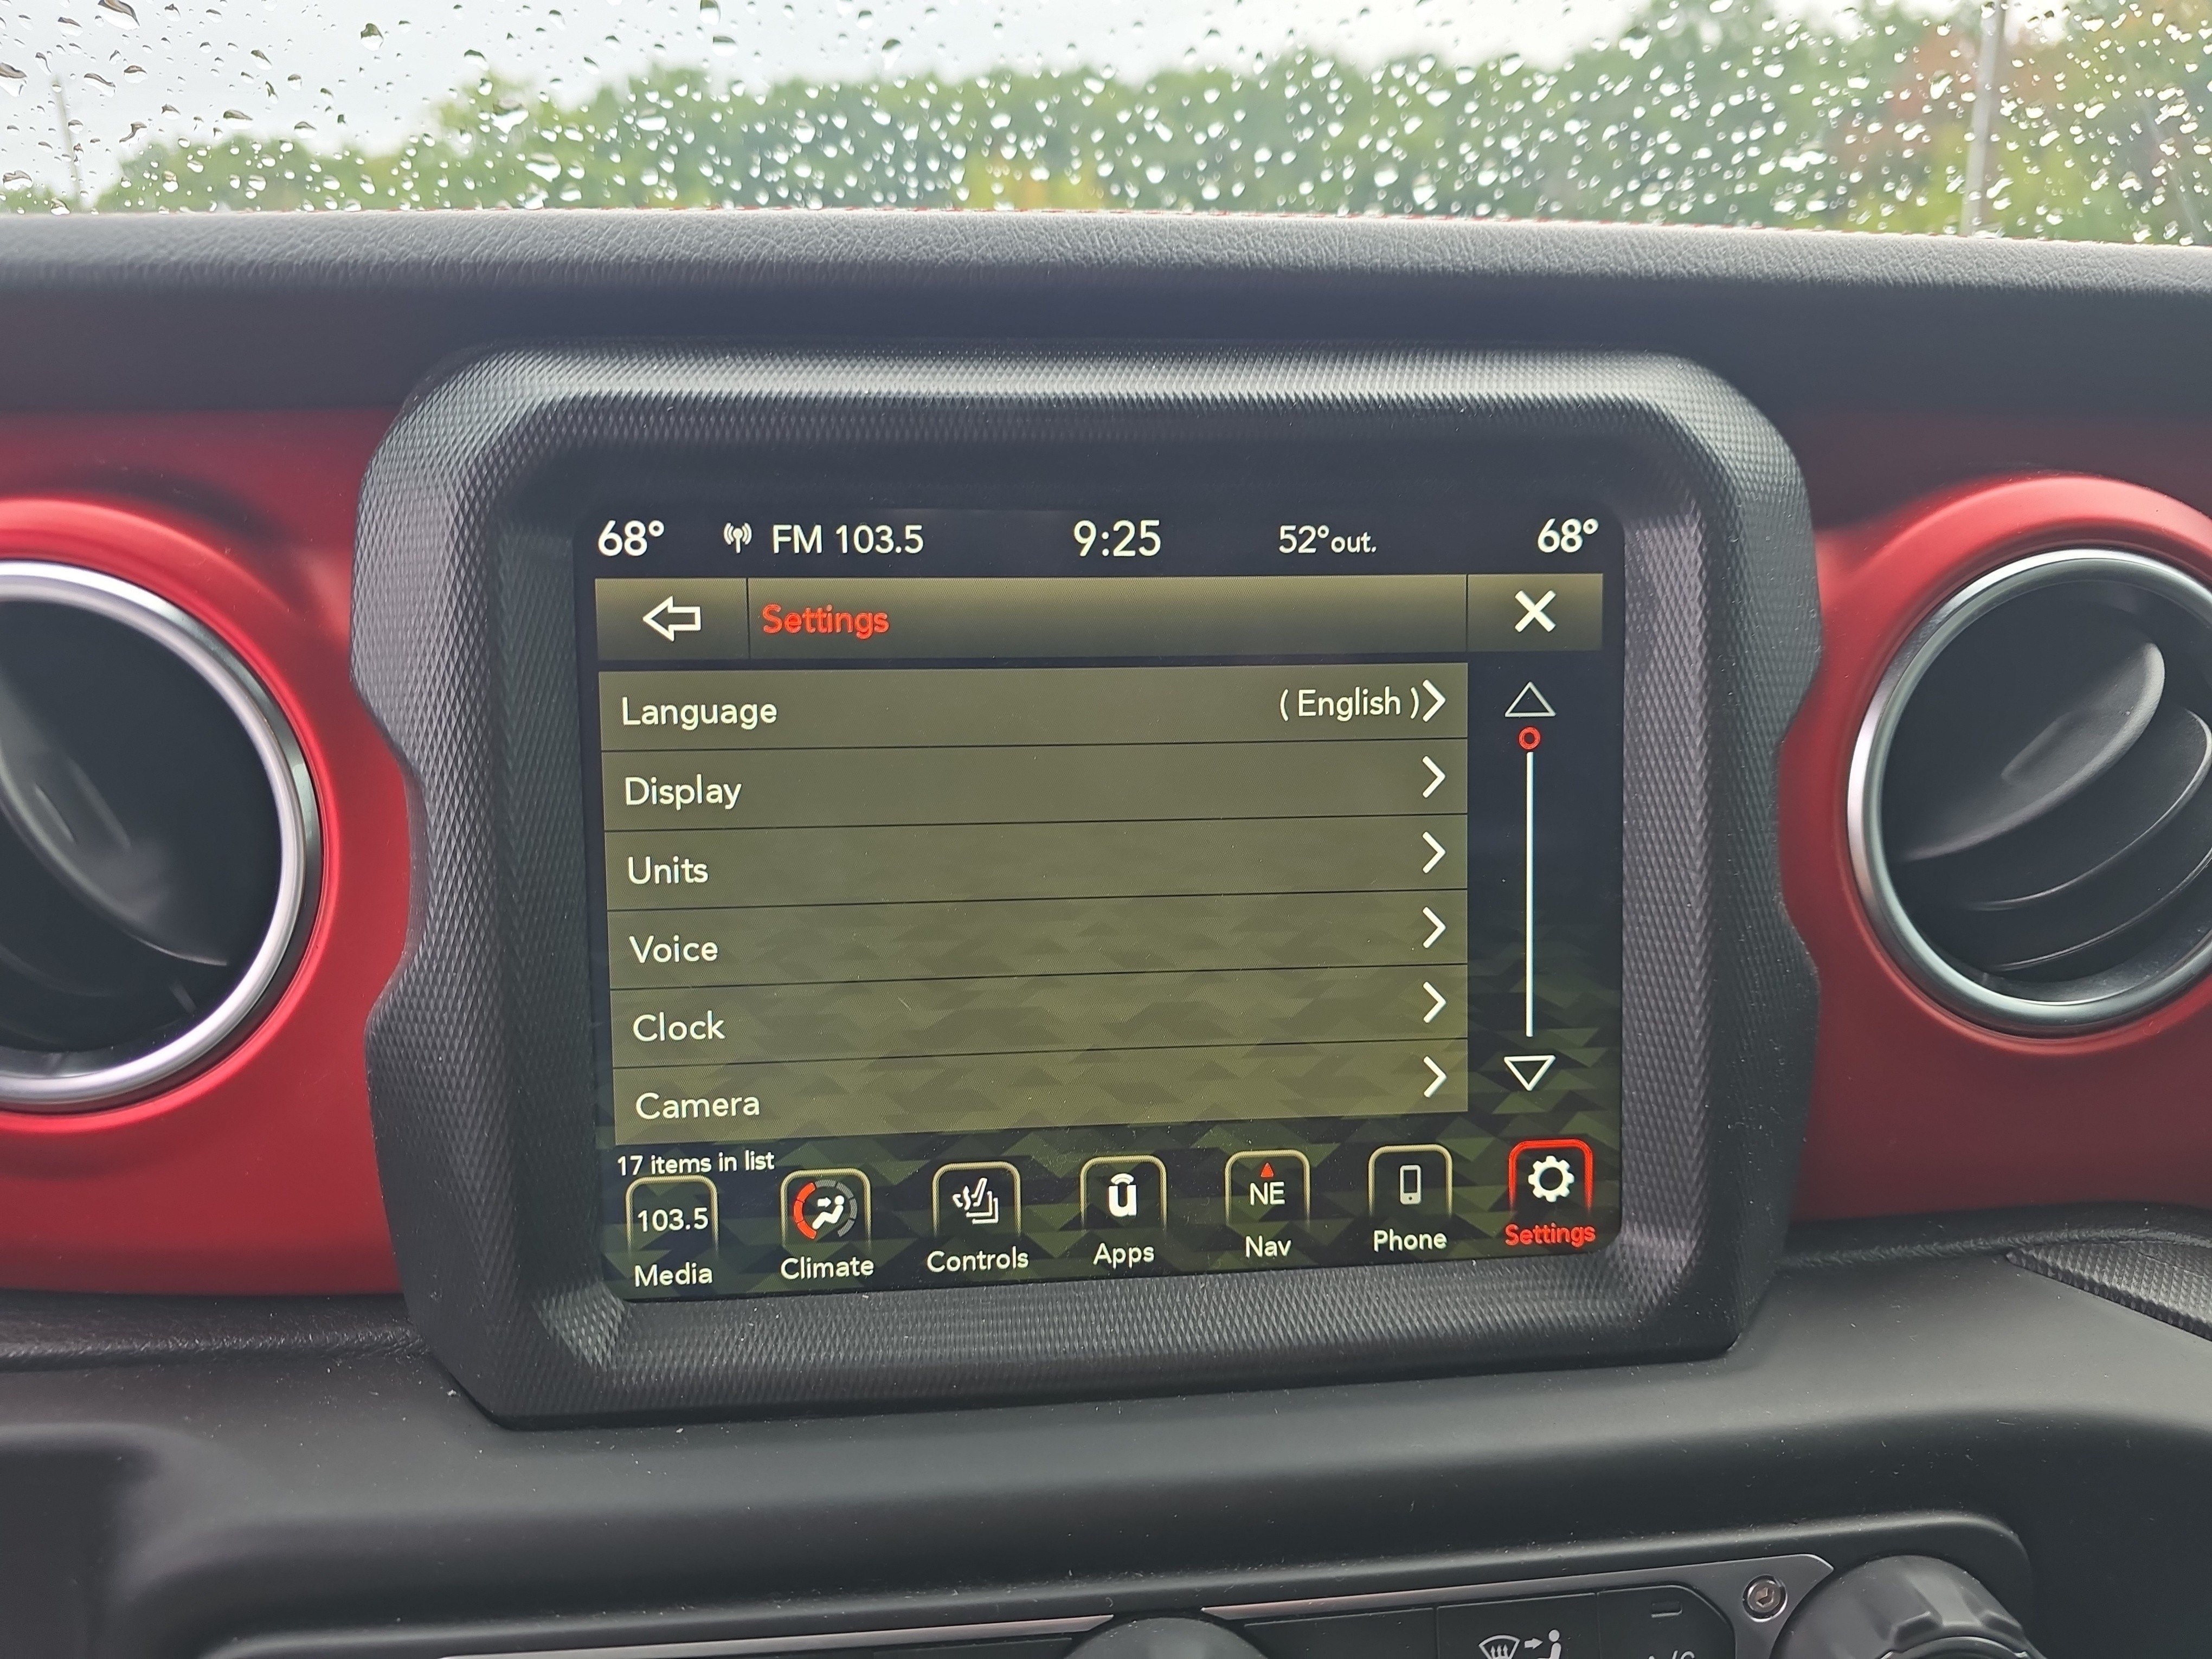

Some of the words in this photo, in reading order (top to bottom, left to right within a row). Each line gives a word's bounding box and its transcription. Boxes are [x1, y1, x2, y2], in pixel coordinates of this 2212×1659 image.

[597, 519, 665, 557] 68°
[772, 524, 822, 554] FM
[835, 524, 924, 554] 103.5
[1073, 519, 1161, 557] 9:25
[1537, 518, 1599, 554] 68°
[762, 604, 889, 640] Settings
[621, 696, 777, 731] Language
[625, 773, 742, 811] Display
[627, 855, 709, 885] Units
[629, 934, 718, 964] Voice
[632, 1009, 726, 1043] Clock
[635, 1092, 760, 1120] Camera
[617, 1155, 643, 1176] 17
[650, 1154, 712, 1175] items
[718, 1151, 738, 1172] in
[744, 1149, 775, 1171] list
[1249, 1181, 1285, 1206] NE
[637, 1207, 709, 1233] 103.5
[1245, 1234, 1292, 1258] Nav
[1373, 1228, 1448, 1252] Phone
[1505, 1223, 1596, 1249] Settings
[780, 1256, 874, 1280] Climate
[927, 1245, 1029, 1273] Controls
[1092, 1242, 1155, 1270] Apps
[634, 1262, 713, 1288] Media
